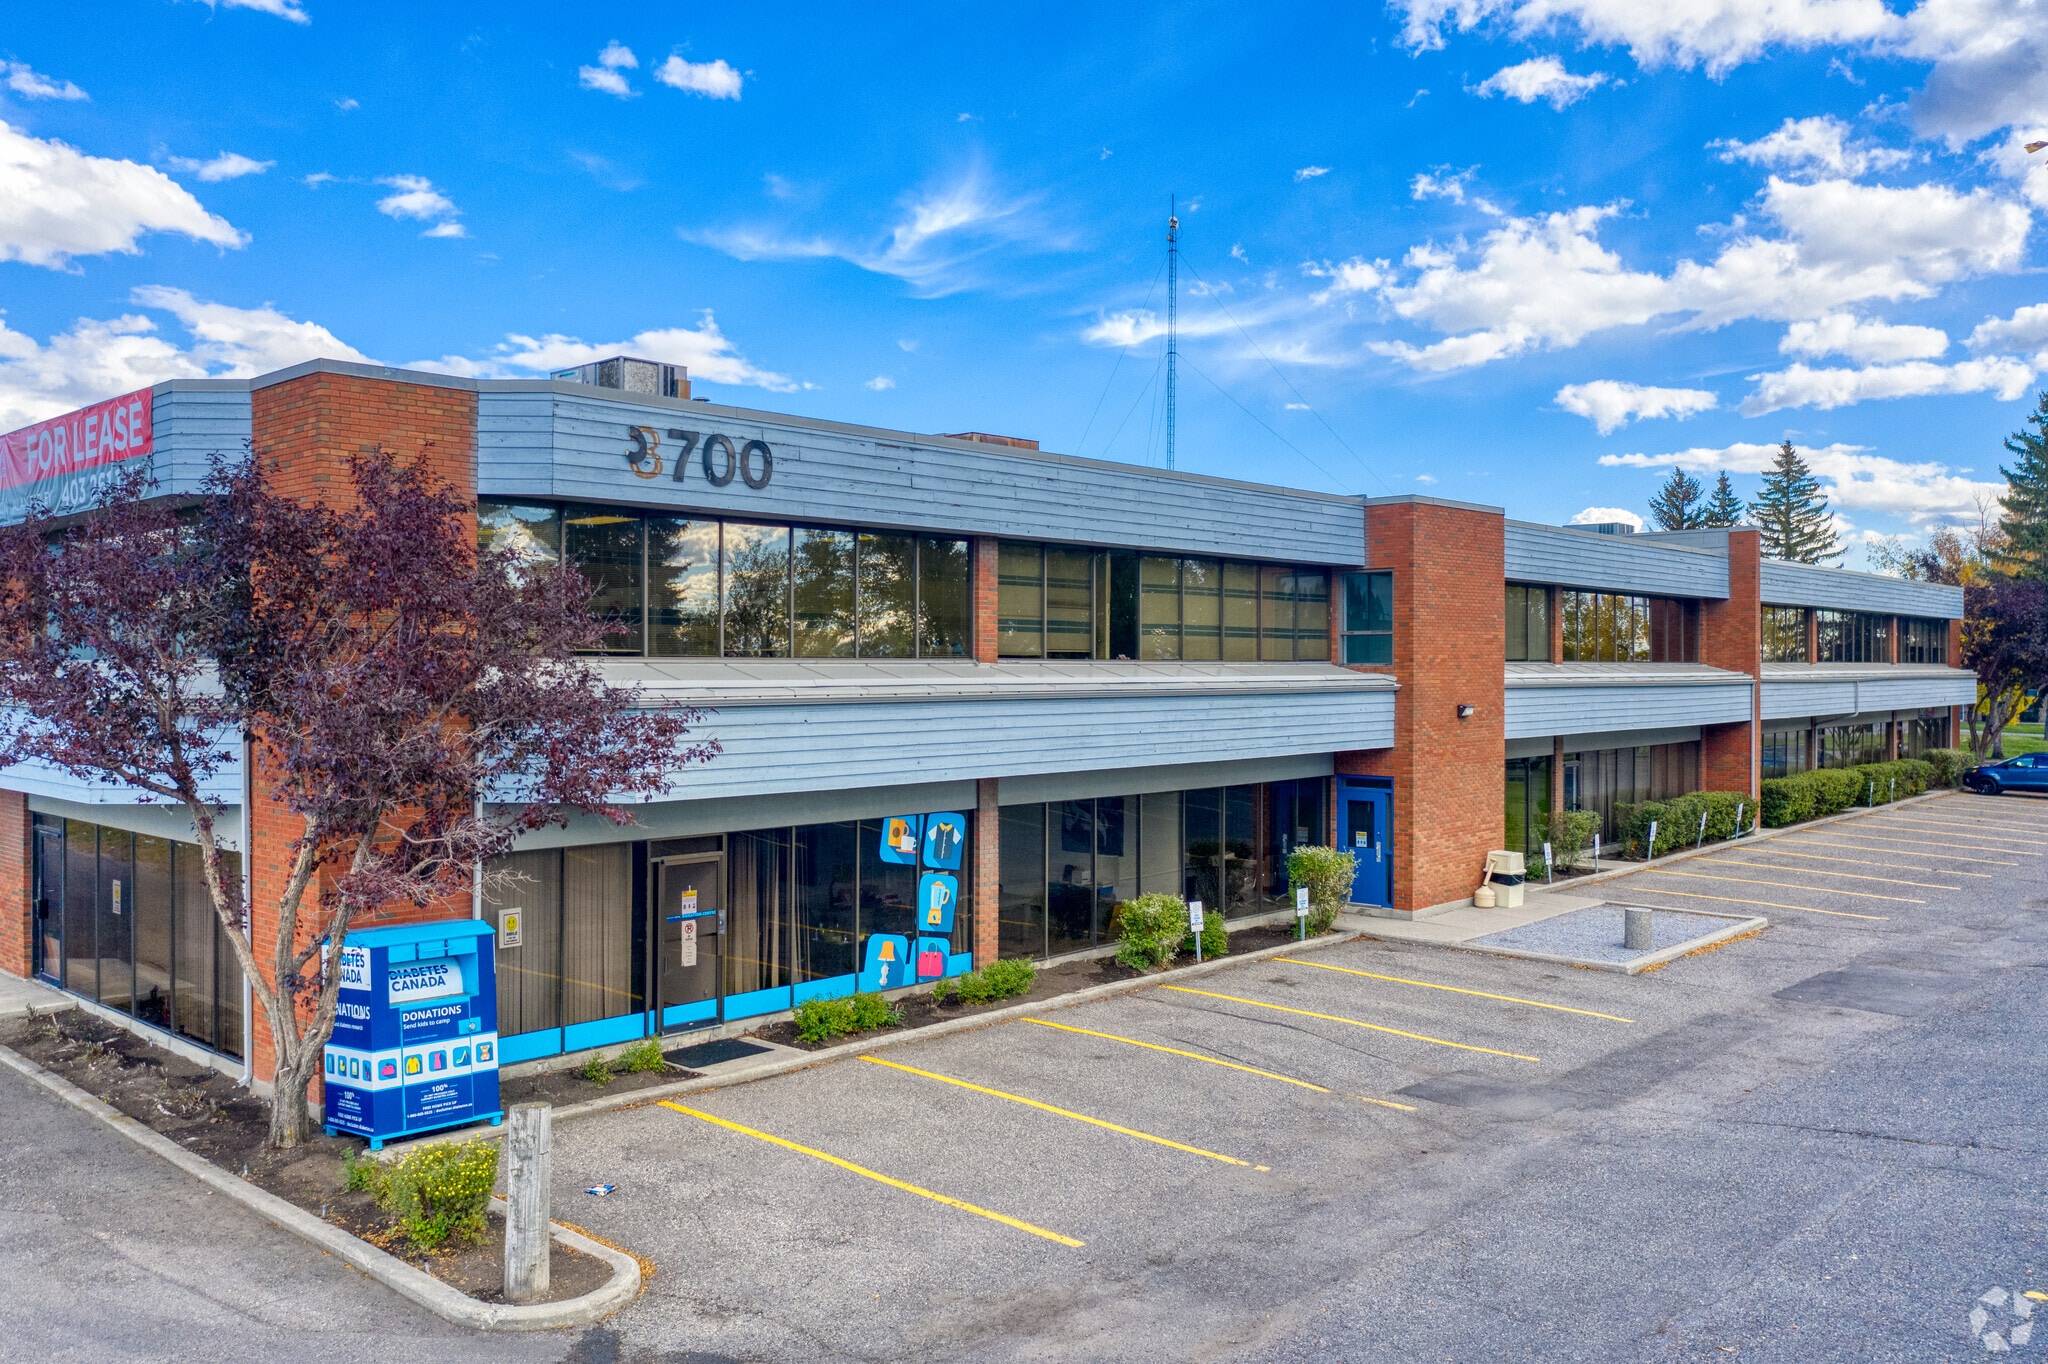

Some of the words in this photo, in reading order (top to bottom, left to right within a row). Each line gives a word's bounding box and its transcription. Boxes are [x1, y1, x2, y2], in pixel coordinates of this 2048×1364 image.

[26, 426, 67, 475] FOR
[73, 401, 144, 463] LEASE
[60, 477, 86, 506] 403
[388, 964, 449, 981] DIABETES
[391, 975, 446, 992] CANADA
[402, 1005, 462, 1022] DONATIONS
[403, 1022, 416, 1030] Send
[431, 1083, 448, 1093] 100%
